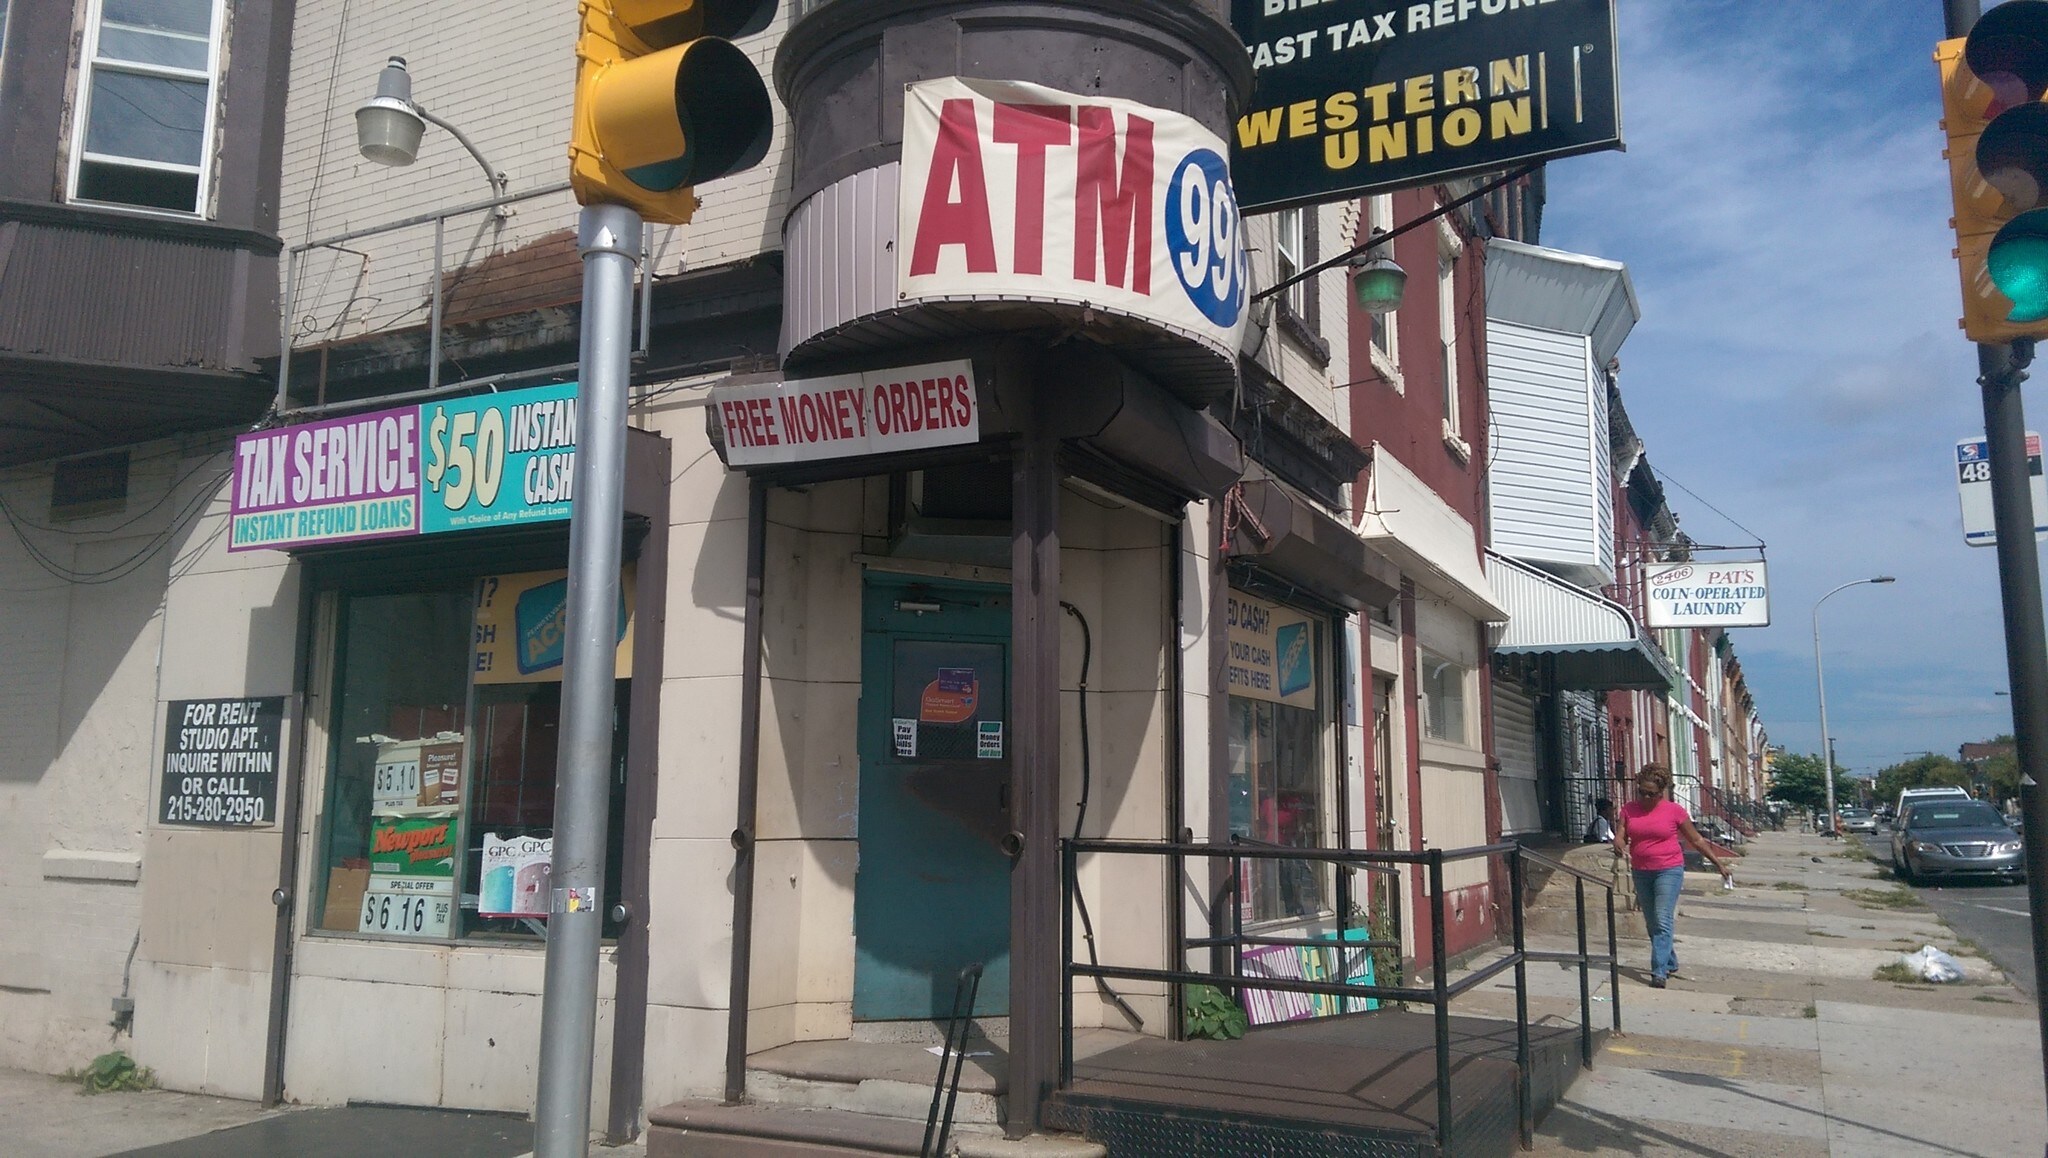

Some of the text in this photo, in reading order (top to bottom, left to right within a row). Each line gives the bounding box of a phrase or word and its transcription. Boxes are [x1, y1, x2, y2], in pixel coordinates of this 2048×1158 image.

[1246, 0, 1558, 70] AST TAX REFU
[1237, 53, 1530, 149] WESTERN
[1324, 96, 1532, 170] UNION
[909, 98, 1155, 297] ATM
[722, 374, 972, 448] FREE MONEY ORDERS
[508, 398, 578, 453] INSTAN
[239, 414, 416, 509] TAX SERVICE
[427, 406, 504, 510] $50
[524, 452, 576, 505] CASH
[1962, 461, 1991, 482] 48
[234, 499, 412, 545] INSTANT REFUND LOANS
[450, 506, 568, 526] With Choice of Any Refund Loan
[1656, 567, 1689, 585] 2406
[1652, 586, 1766, 600] COIN-OPERATED
[1228, 598, 1239, 627] ED
[1673, 602, 1746, 616] LAUNDRY
[475, 624, 497, 643] SH
[1230, 640, 1271, 667] YOUR CASH
[1229, 666, 1272, 691] EFITS HERE!
[183, 702, 262, 726] FOR RENT
[180, 726, 259, 750] STUDIO APT.
[897, 725, 912, 733] Pay
[980, 733, 1000, 741] Money
[980, 740, 1000, 748] Orders
[166, 751, 273, 774] INQUIRE WITHIN
[181, 777, 250, 795] OR CALL
[377, 765, 415, 791] $5.10
[167, 795, 265, 823] 215-280-2950
[372, 824, 449, 855] Newport
[488, 846, 516, 857] GPC
[521, 841, 552, 853] GPC
[415, 881, 435, 890] OFFER
[365, 895, 425, 932] $6.16
[435, 902, 449, 914] PLUS
[435, 913, 446, 924] TAX
